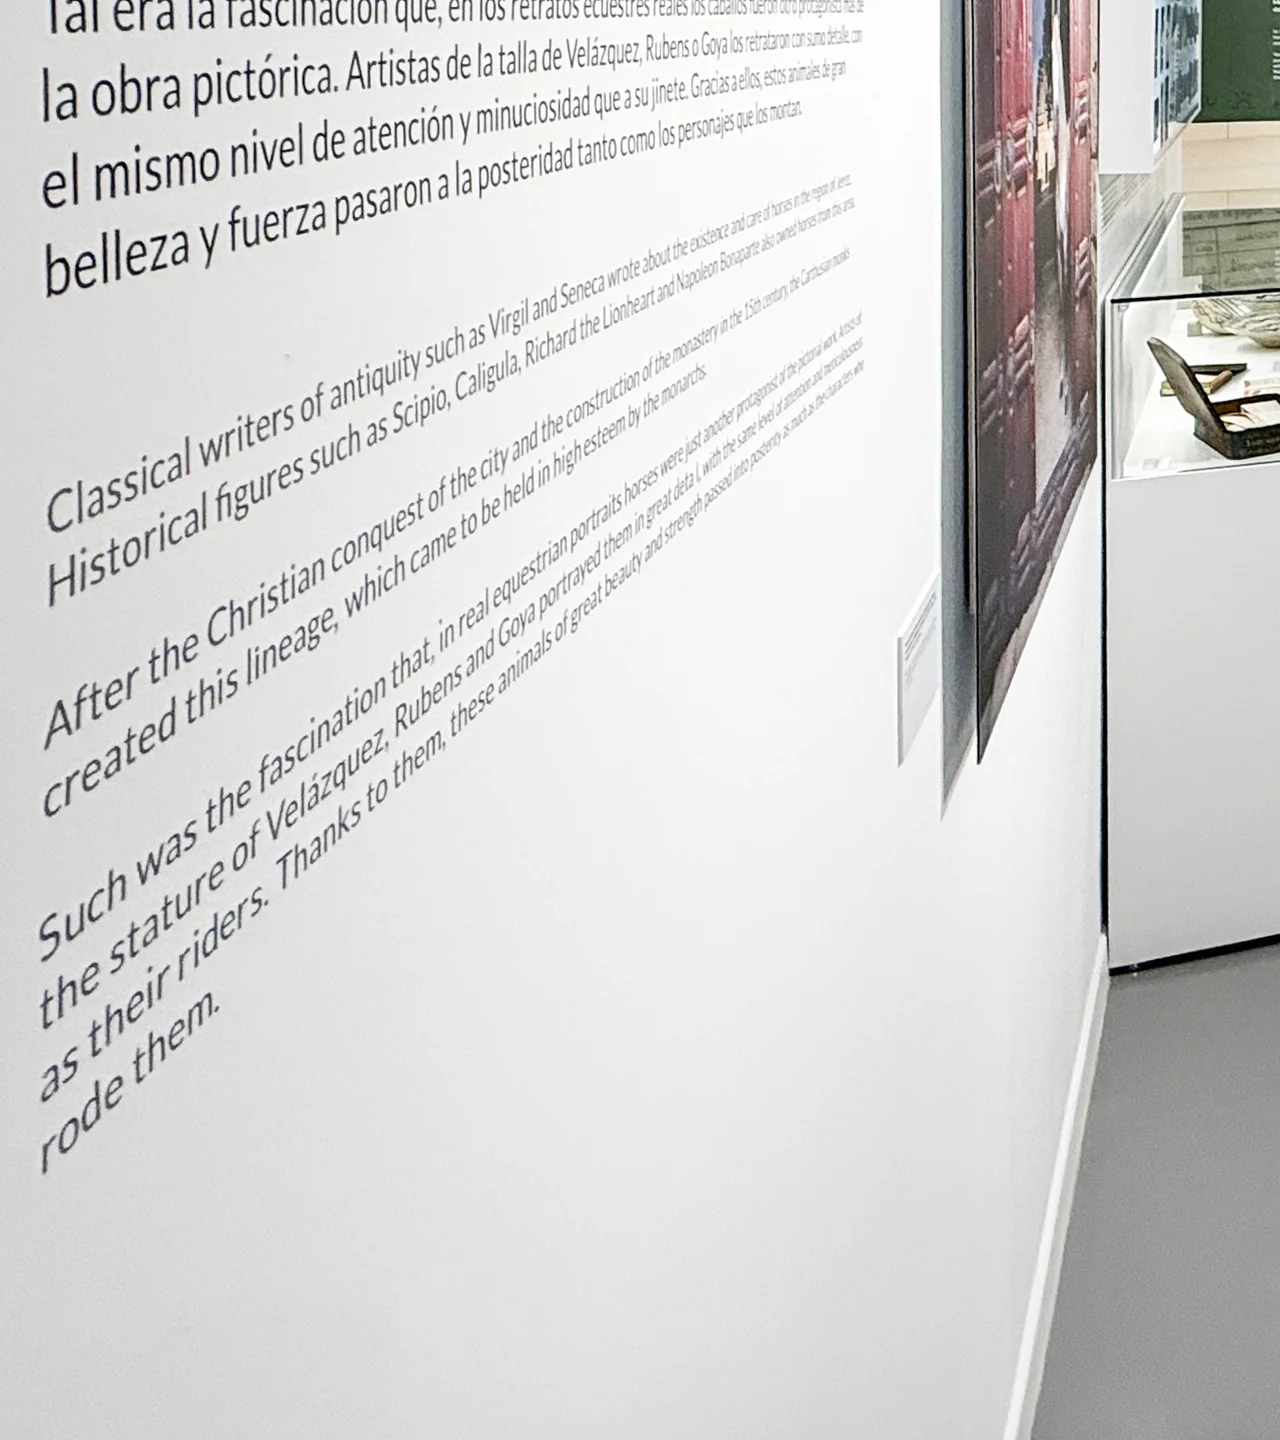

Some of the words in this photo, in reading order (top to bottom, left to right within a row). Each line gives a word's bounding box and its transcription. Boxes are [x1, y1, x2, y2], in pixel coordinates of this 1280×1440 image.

[42, 67, 78, 122] la
[92, 62, 181, 117] obra
[193, 53, 339, 118] pictórica.
[345, 48, 441, 91] Artistas
[42, 151, 79, 209] el
[95, 144, 220, 201] mismo
[231, 122, 303, 178] nivel
[312, 118, 346, 163] de
[45, 229, 189, 298] belleza
[199, 222, 220, 269] y
[227, 200, 326, 252] fuerza
[335, 177, 432, 225] pasaron
[47, 436, 191, 533] Classical
[198, 404, 295, 468] writers
[300, 381, 324, 423] of
[330, 349, 421, 411] antiquity
[49, 491, 207, 608] Historical
[215, 457, 304, 522] figures
[310, 422, 361, 475] such
[366, 416, 388, 447] as
[43, 666, 140, 751] After
[148, 633, 199, 685] the
[207, 557, 325, 647] Christian
[331, 493, 424, 573] conquest
[428, 475, 447, 513] of
[43, 695, 176, 818] created
[185, 667, 238, 724] this
[246, 607, 339, 686] lineage,
[344, 554, 406, 618] which
[39, 869, 127, 963] Such
[136, 819, 197, 886] was
[205, 779, 252, 834] the
[258, 676, 386, 794] fascination
[391, 637, 435, 689] that,
[39, 961, 100, 1030] the
[110, 861, 225, 975] stature
[232, 818, 261, 872] of
[266, 727, 389, 841] Velázquez,
[41, 1046, 78, 1103] as
[88, 964, 171, 1058] their
[178, 886, 269, 982] riders.
[275, 800, 361, 890] Thanks
[366, 778, 388, 812] to
[392, 730, 446, 789] them,
[42, 1075, 124, 1174] rode
[132, 992, 220, 1084] them.
